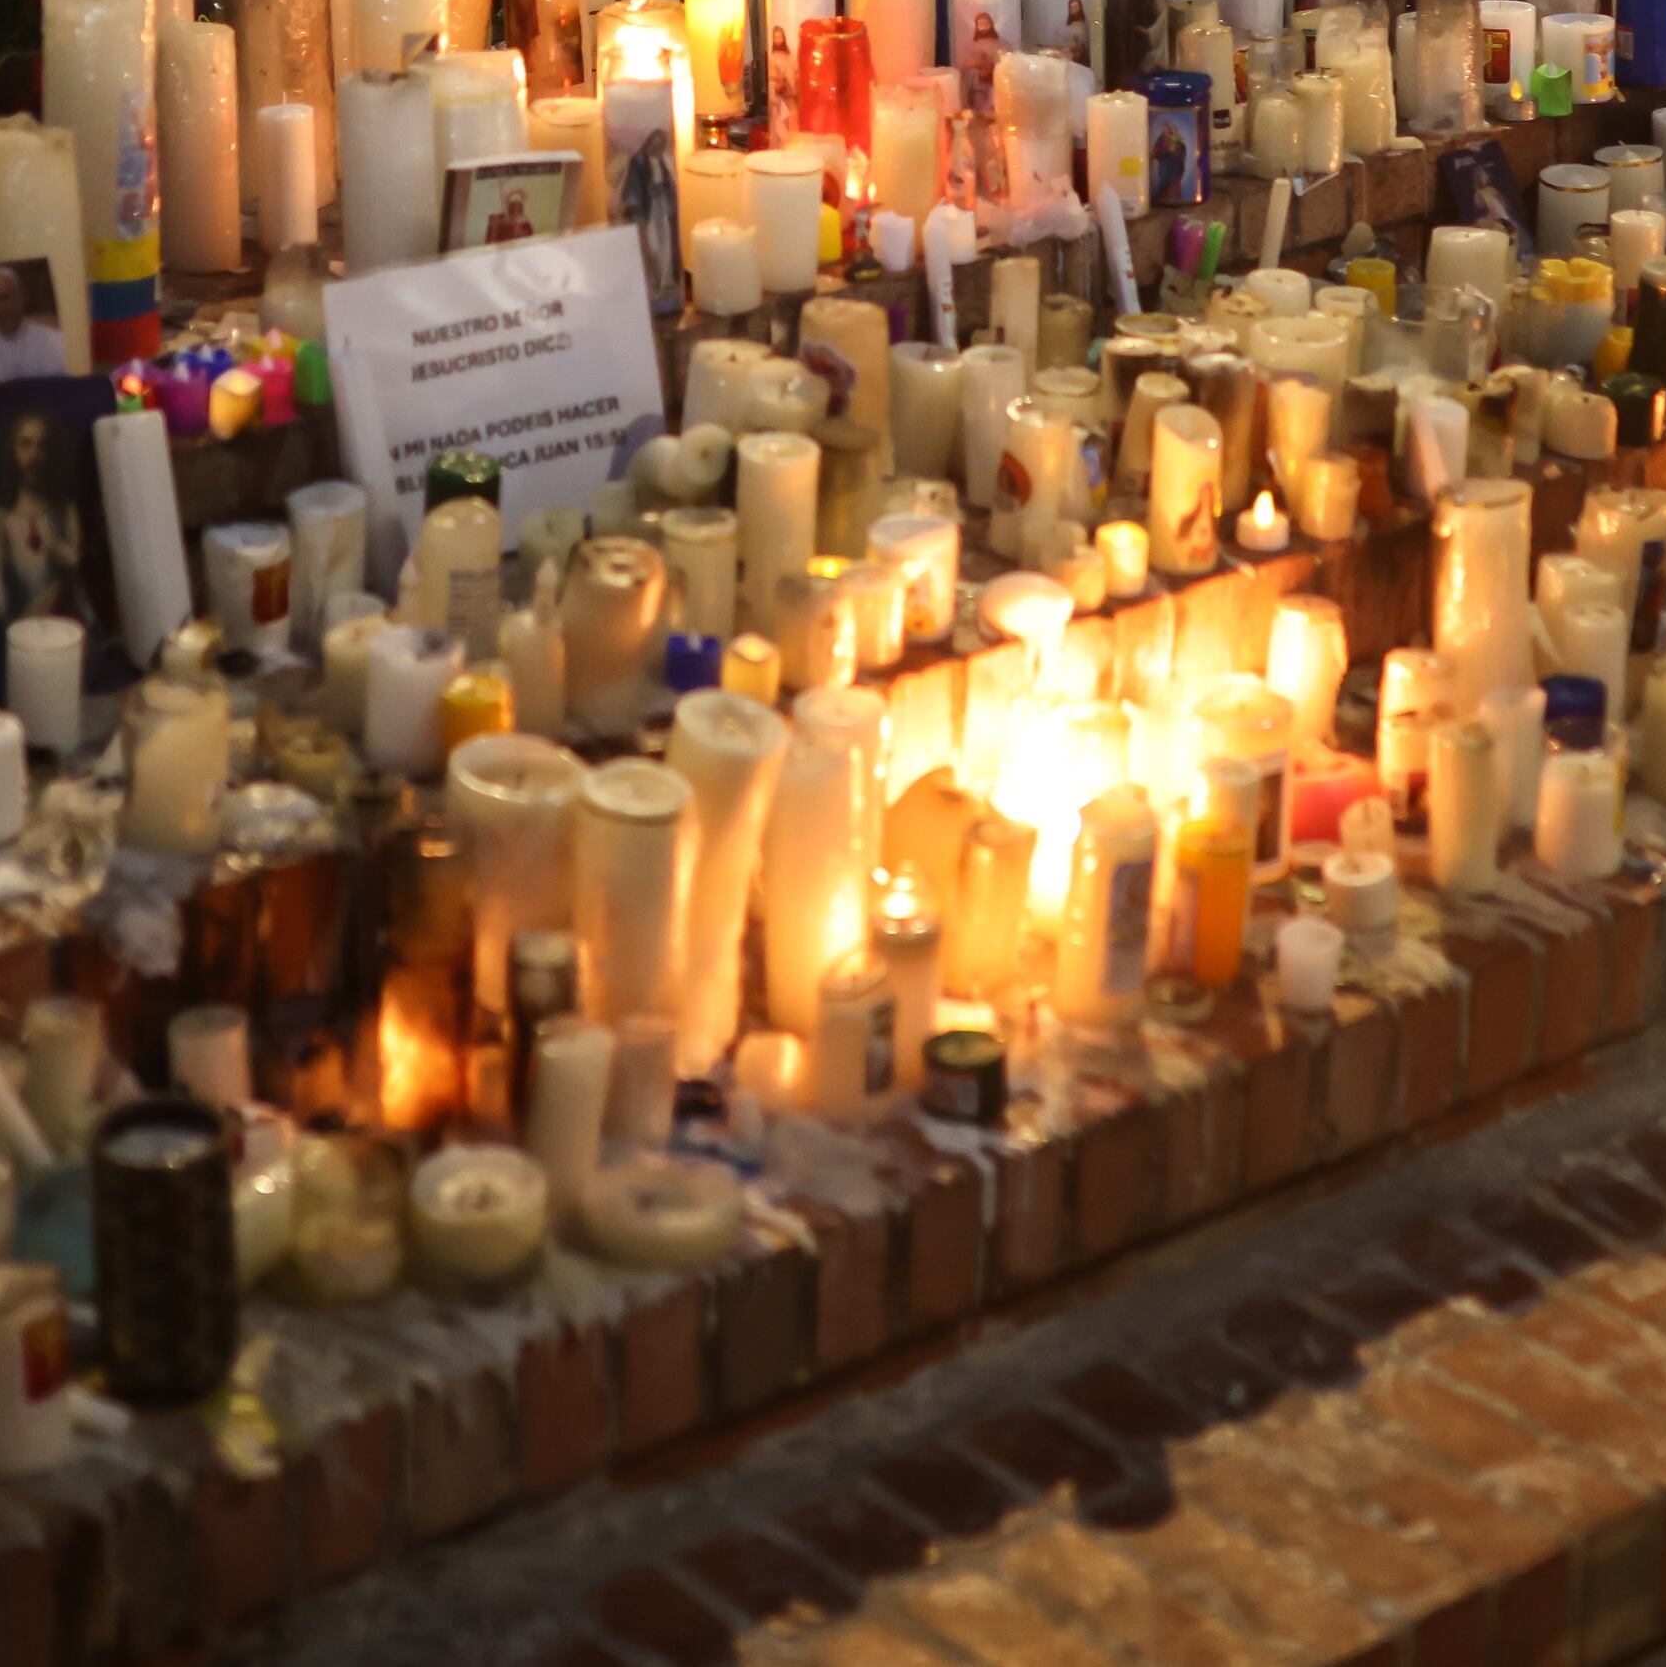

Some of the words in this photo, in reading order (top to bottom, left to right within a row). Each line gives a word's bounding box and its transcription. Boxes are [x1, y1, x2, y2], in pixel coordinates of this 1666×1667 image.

[412, 314, 497, 347] NUESTRO
[503, 299, 564, 329] SEOR
[430, 428, 482, 451] NADA
[557, 395, 620, 422] HACER
